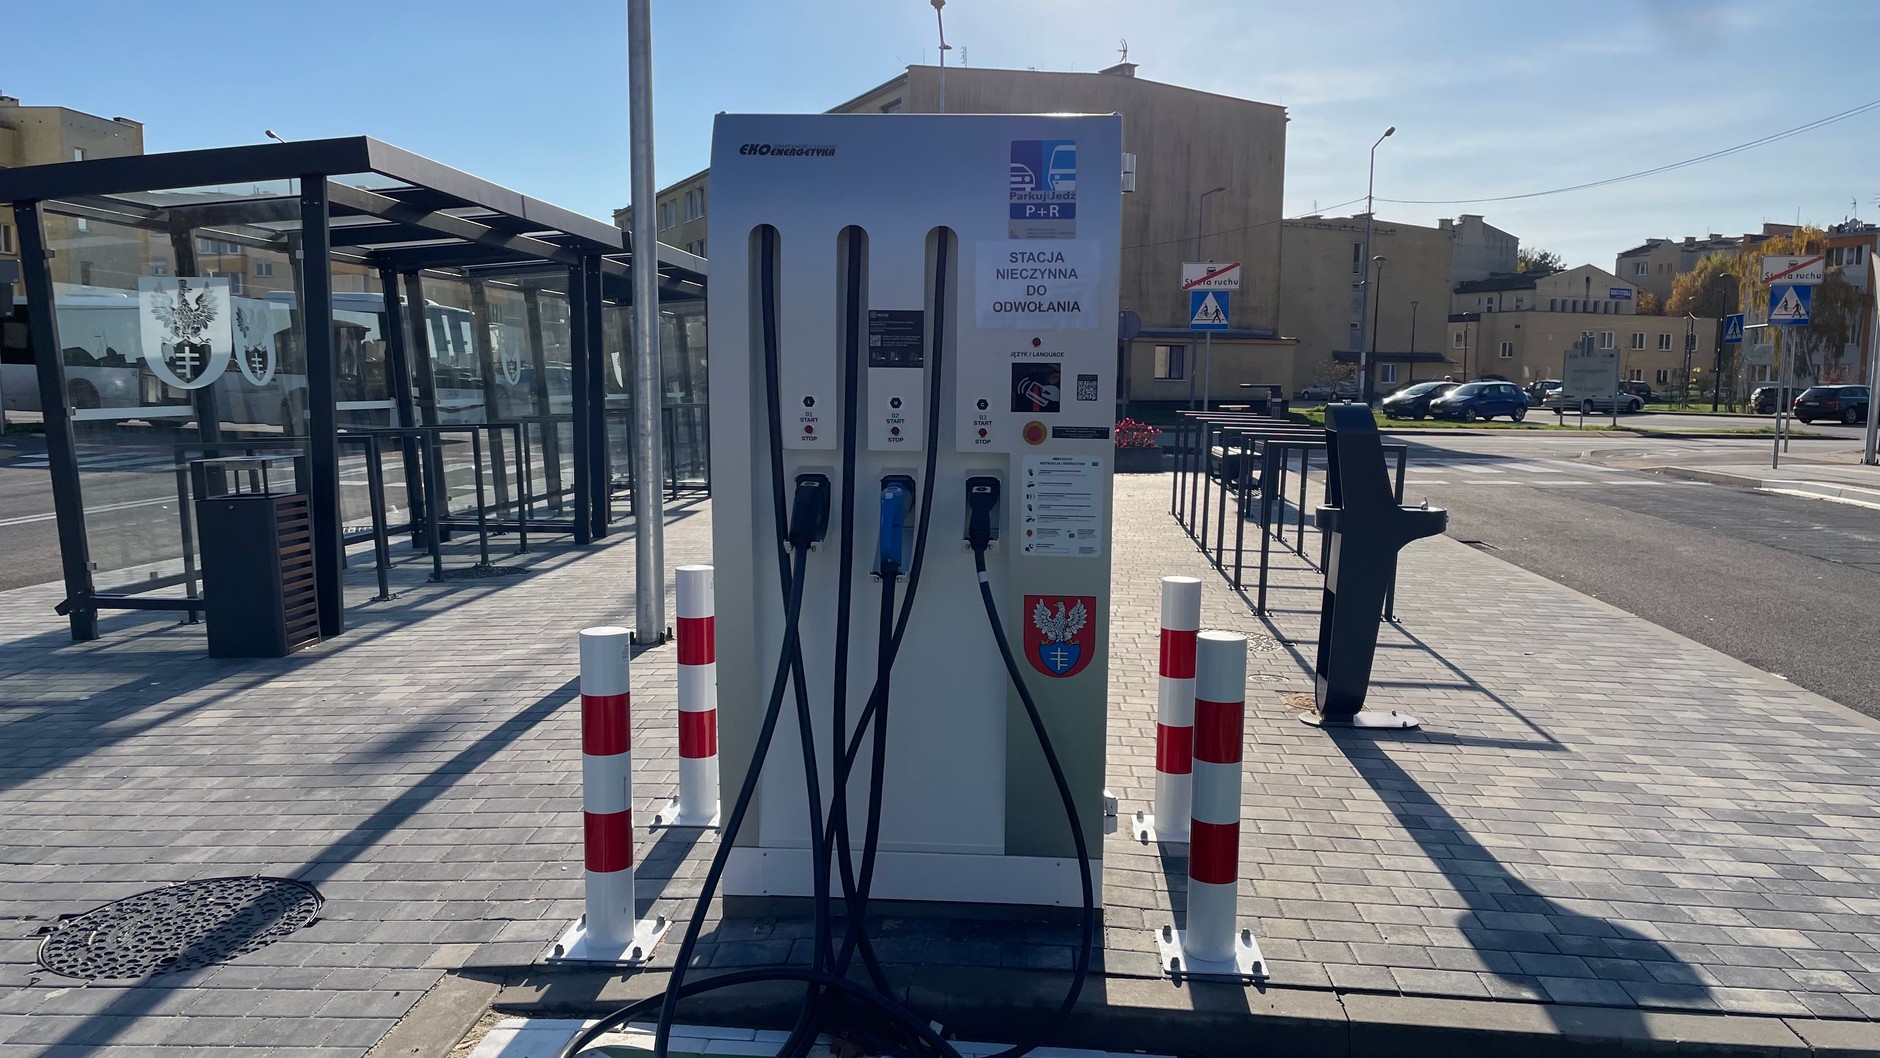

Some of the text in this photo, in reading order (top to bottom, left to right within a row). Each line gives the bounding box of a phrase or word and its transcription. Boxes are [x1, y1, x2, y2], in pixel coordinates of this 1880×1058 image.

[1009, 191, 1047, 202] Parkuj
[1025, 204, 1060, 217] P+R
[1009, 251, 1065, 263] STACJA
[996, 268, 1078, 280] NIECZYNNA
[1764, 271, 1822, 280] Sta ruchu
[1184, 277, 1239, 287] Sta ruchu
[1026, 284, 1047, 296] DO
[992, 301, 1081, 313] ODWOŁANIA
